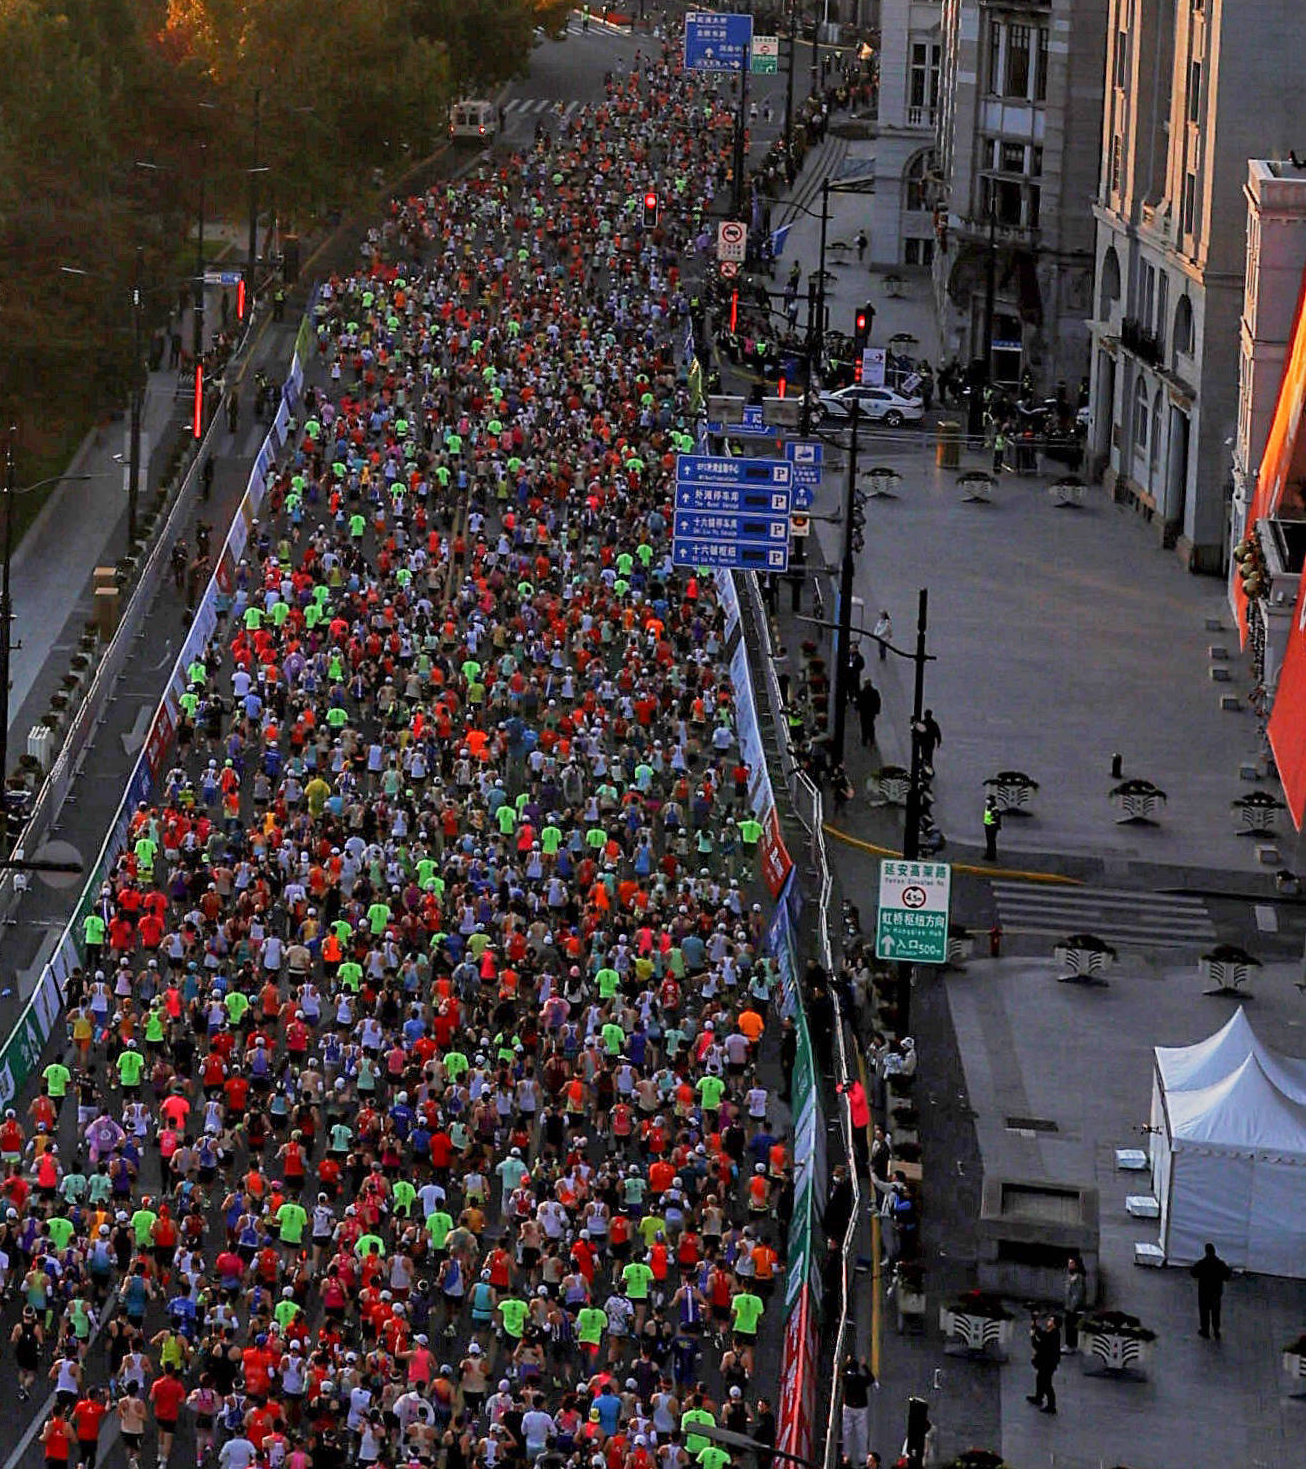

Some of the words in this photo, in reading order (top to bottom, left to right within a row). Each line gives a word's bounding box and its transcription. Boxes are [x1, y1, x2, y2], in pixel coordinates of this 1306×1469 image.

[777, 469, 785, 479] P
[776, 496, 784, 507] P
[774, 525, 782, 536] P
[772, 553, 780, 563] P
[885, 863, 946, 879] 延安高架路
[882, 912, 944, 928] 虹桥枢纽方向
[897, 939, 918, 949] 入口
